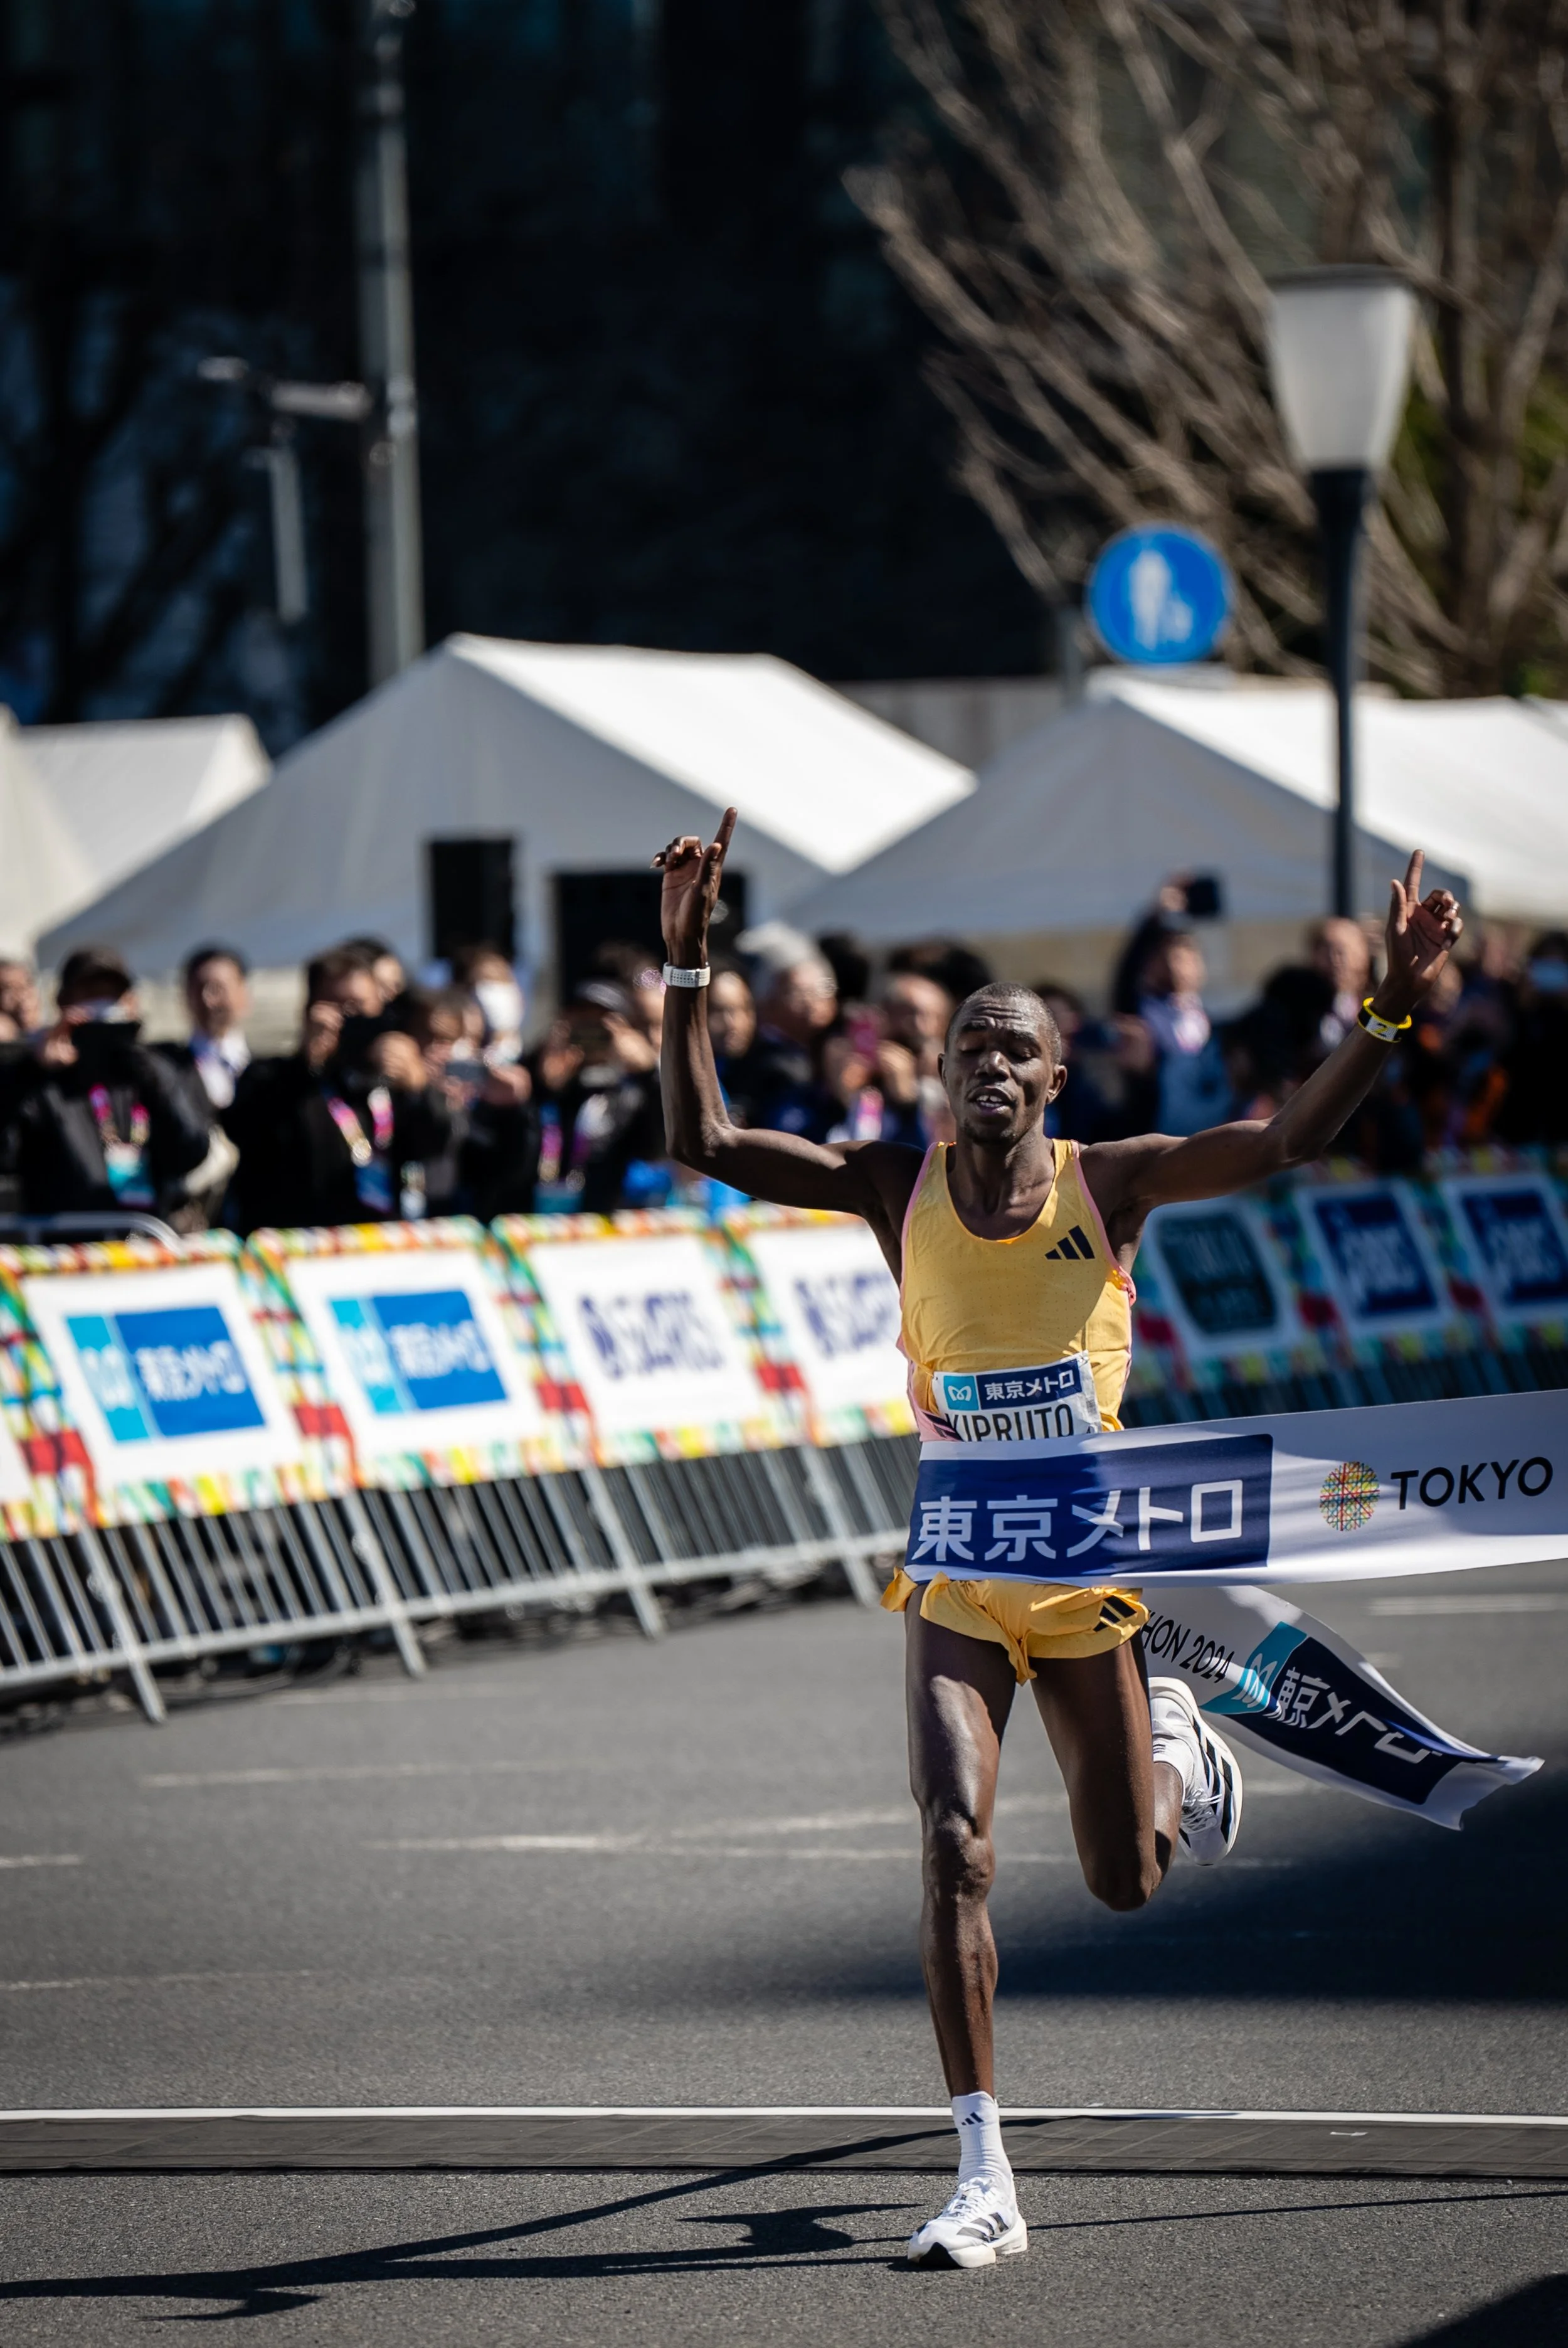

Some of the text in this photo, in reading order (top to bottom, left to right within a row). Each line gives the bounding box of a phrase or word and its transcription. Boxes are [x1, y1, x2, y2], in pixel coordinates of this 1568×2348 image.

[984, 1369, 1075, 1401] 東京メトロ
[944, 1403, 1074, 1442] KIPRUTO
[1390, 1456, 1554, 1511] TOKYO
[911, 1479, 1243, 1562] 東京メトロ
[1142, 1610, 1235, 1684] HON 2024
